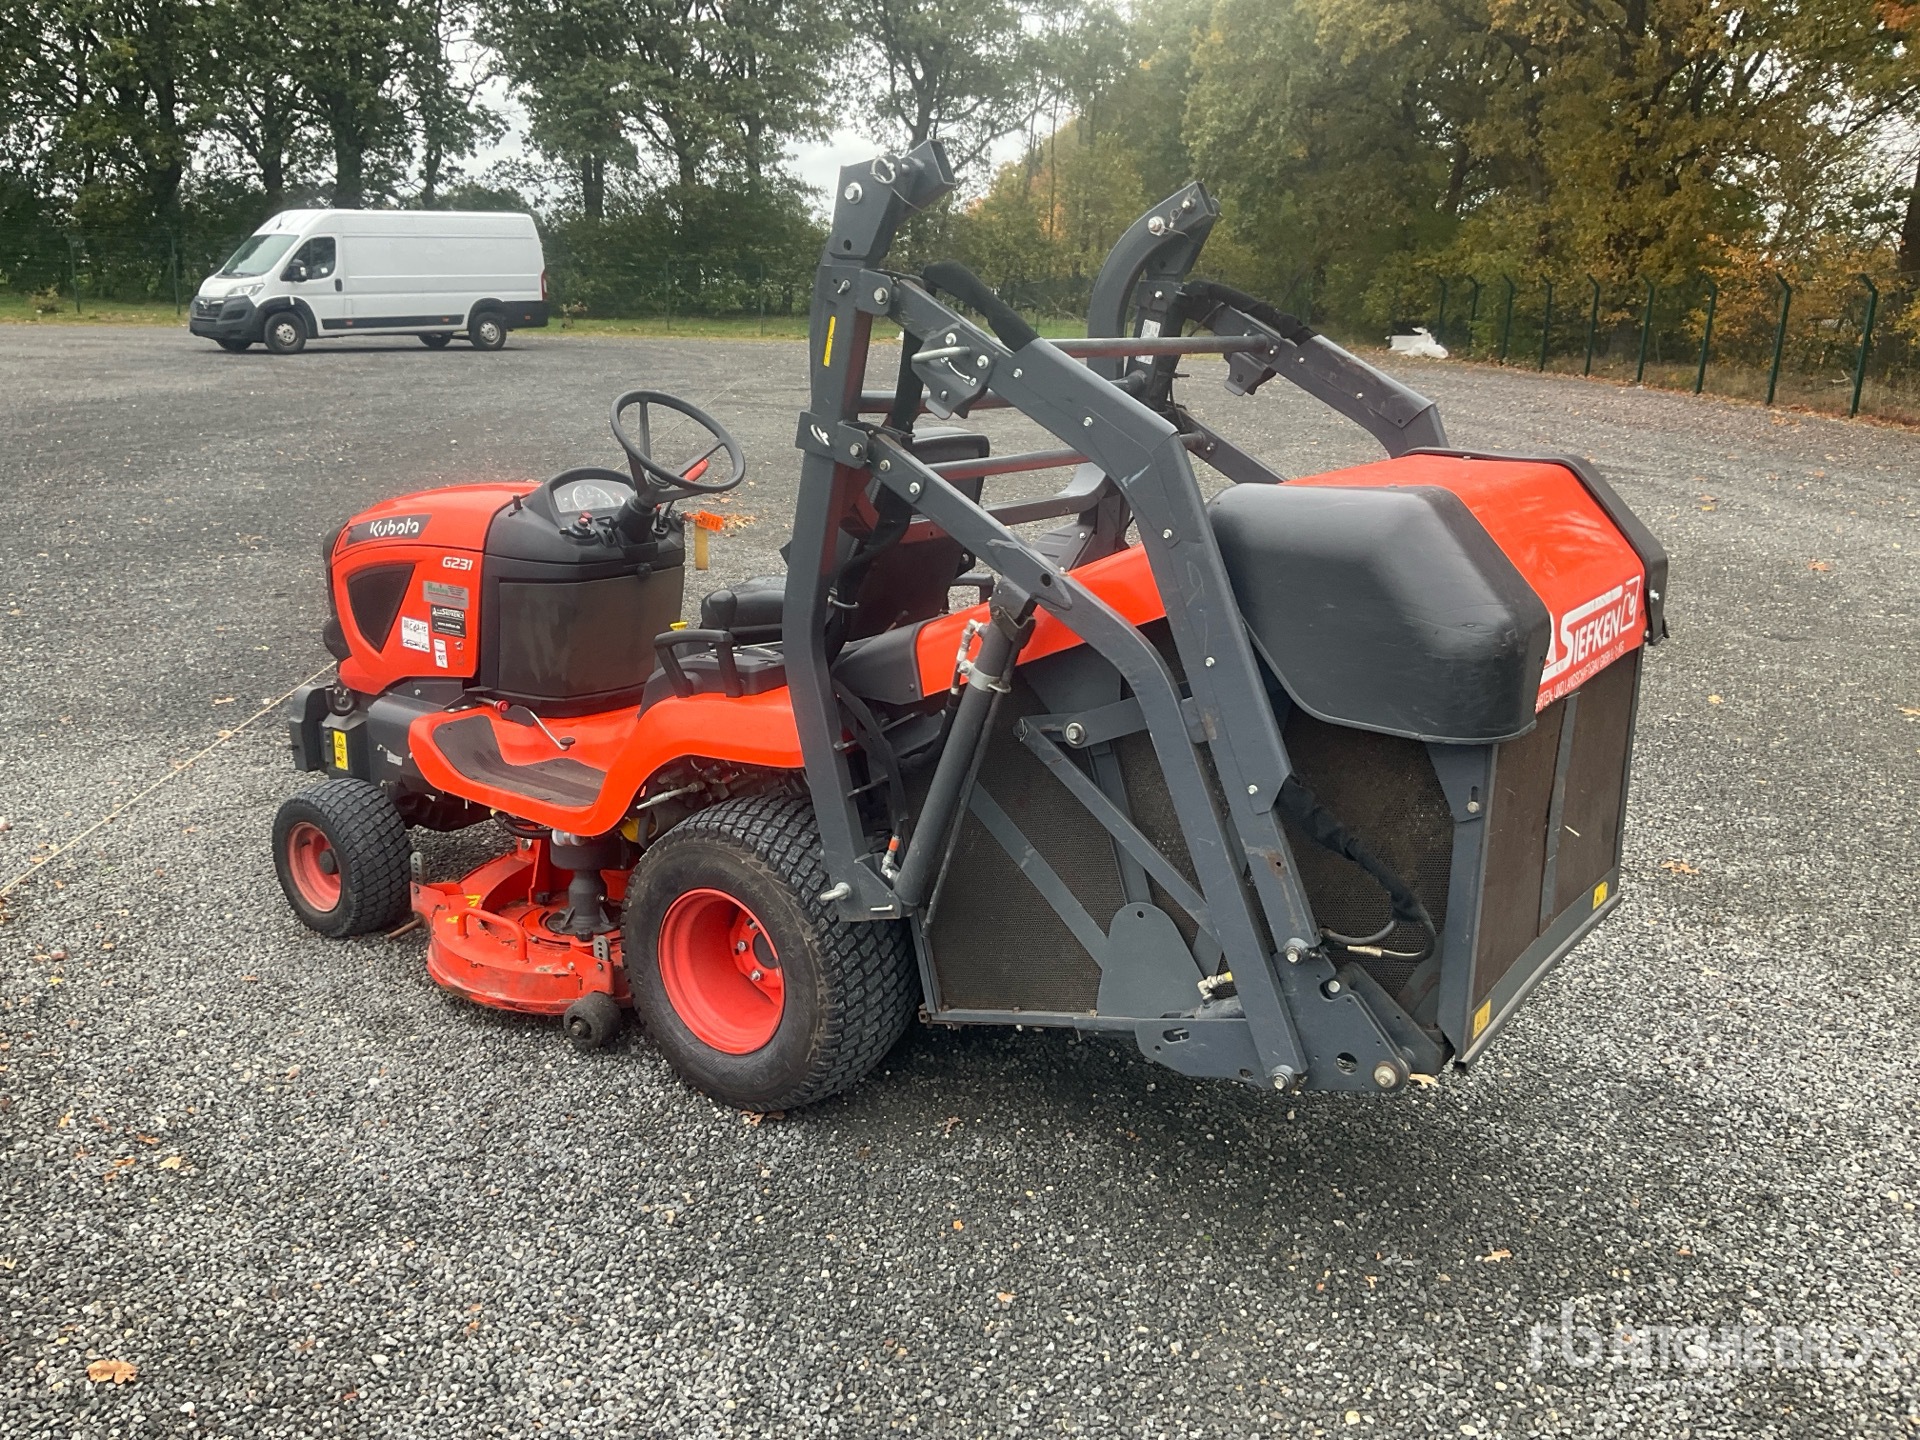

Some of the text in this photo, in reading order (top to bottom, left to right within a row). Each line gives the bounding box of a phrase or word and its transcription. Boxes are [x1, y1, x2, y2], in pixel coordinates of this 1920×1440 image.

[369, 517, 420, 537] Kubota
[442, 556, 473, 571] G231
[1545, 588, 1622, 681] SIEFKEN
